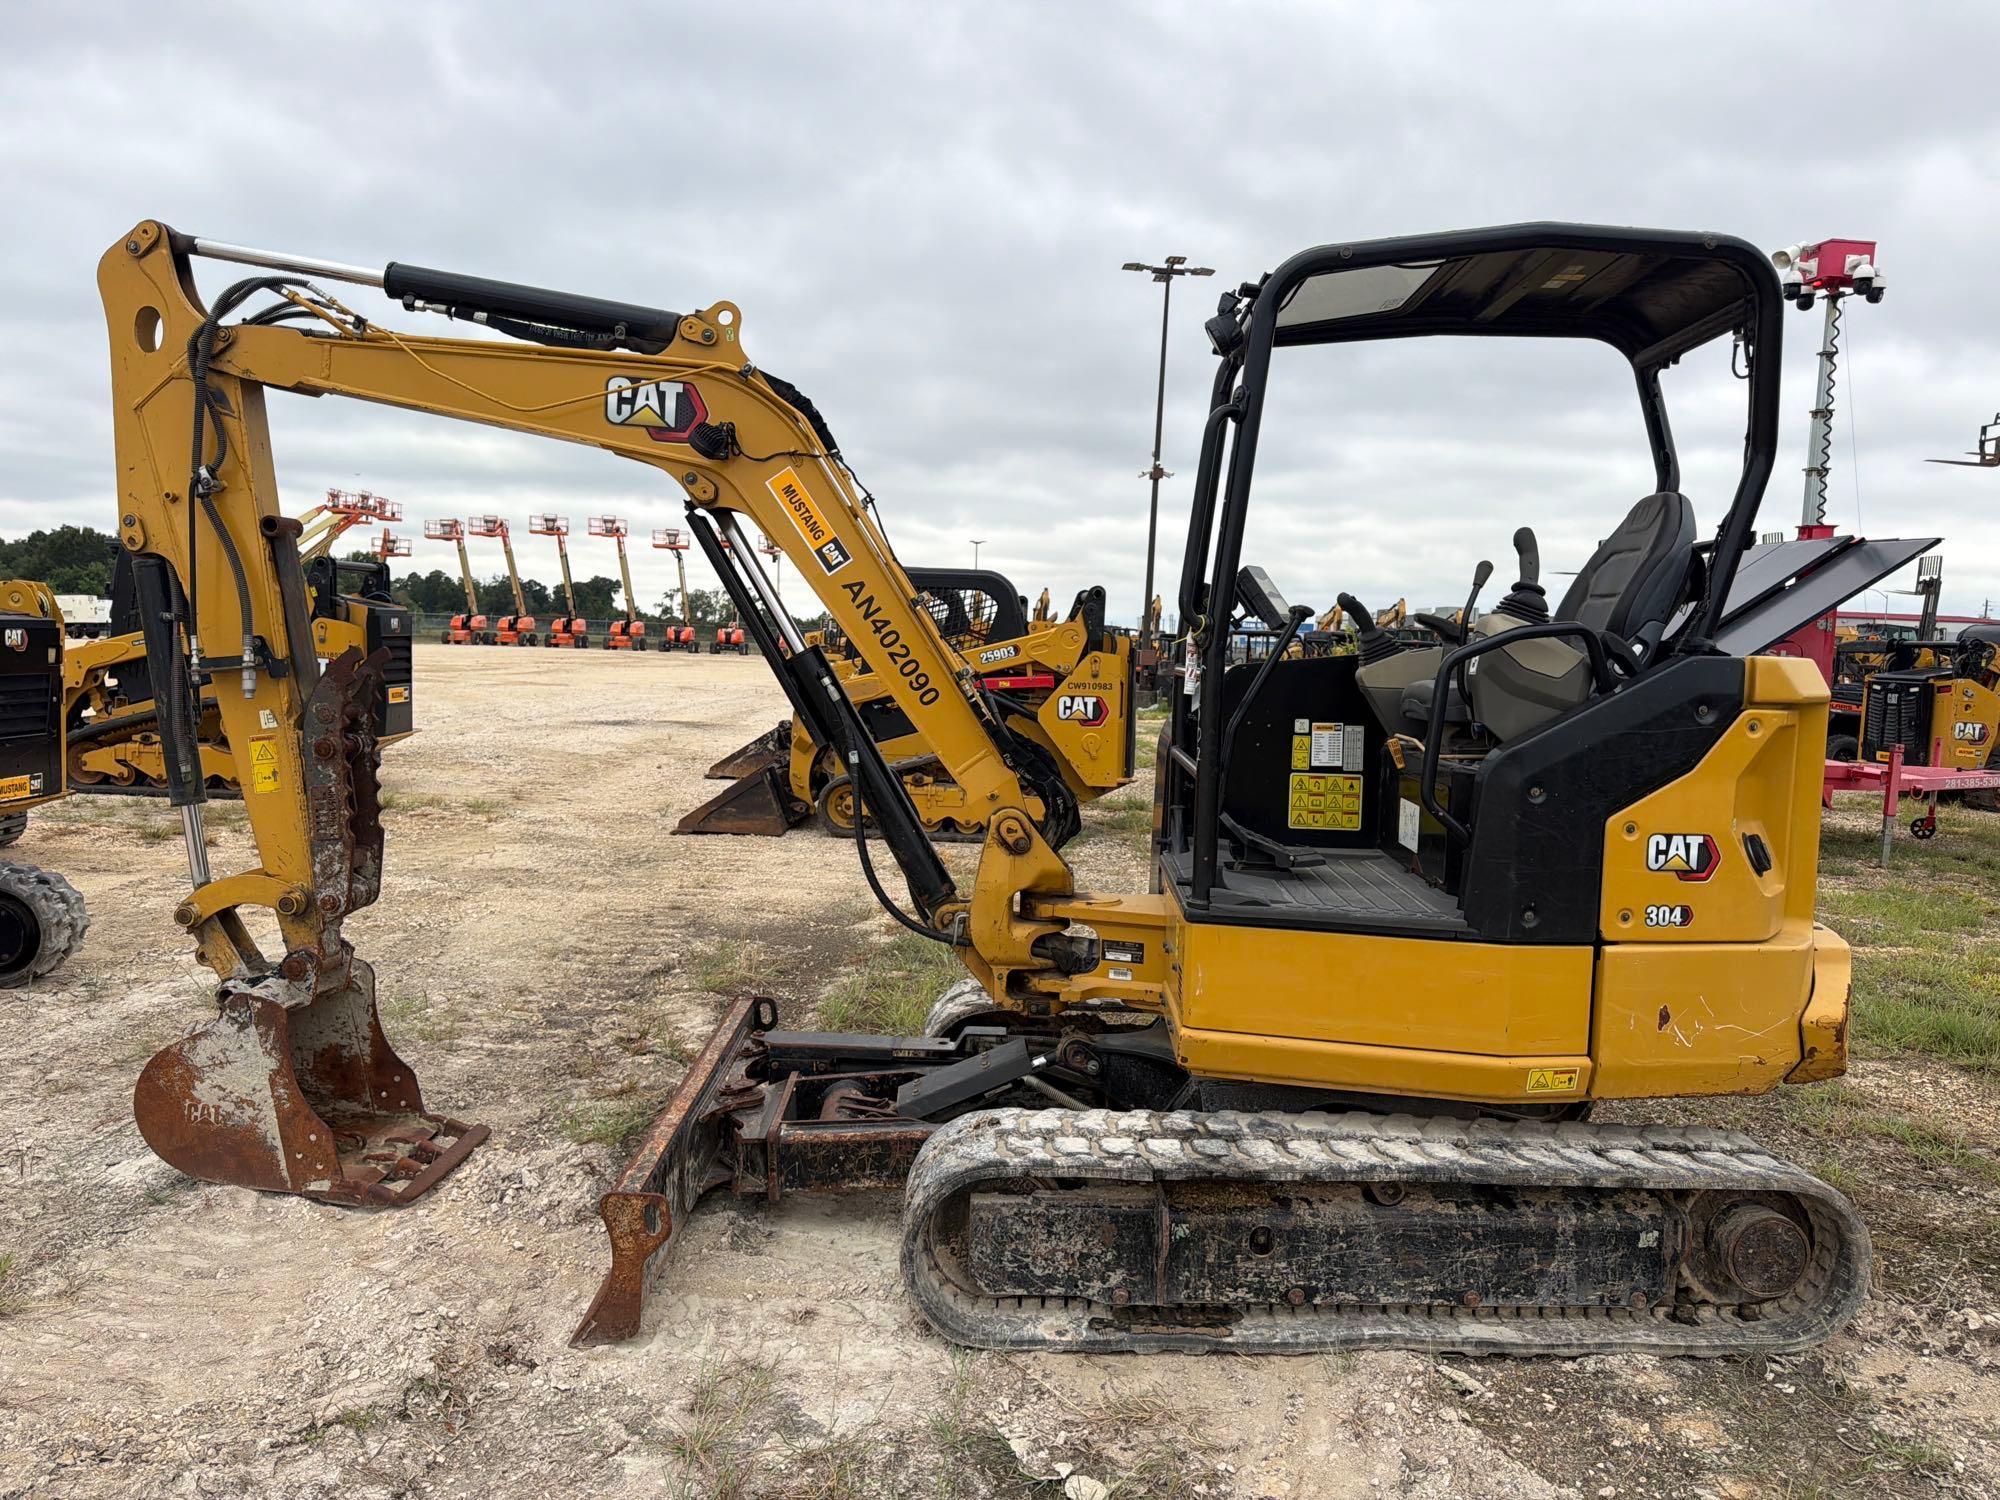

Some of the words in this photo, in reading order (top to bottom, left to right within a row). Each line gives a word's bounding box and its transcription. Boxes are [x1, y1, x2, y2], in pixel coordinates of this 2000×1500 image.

[606, 376, 684, 428] CAT
[781, 483, 825, 541] MUSTANG
[822, 542, 845, 567] CAT
[4, 628, 23, 647] CAT
[841, 580, 940, 706] AN402090
[980, 645, 1016, 664] 259D3
[1067, 682, 1113, 691] CW910983
[1057, 695, 1098, 721] CAT
[1831, 702, 1853, 711] LARIS
[1954, 722, 1983, 741] CAT
[1647, 834, 1704, 871] CAT
[1645, 905, 1683, 926] 304
[186, 1102, 222, 1125] CAT
